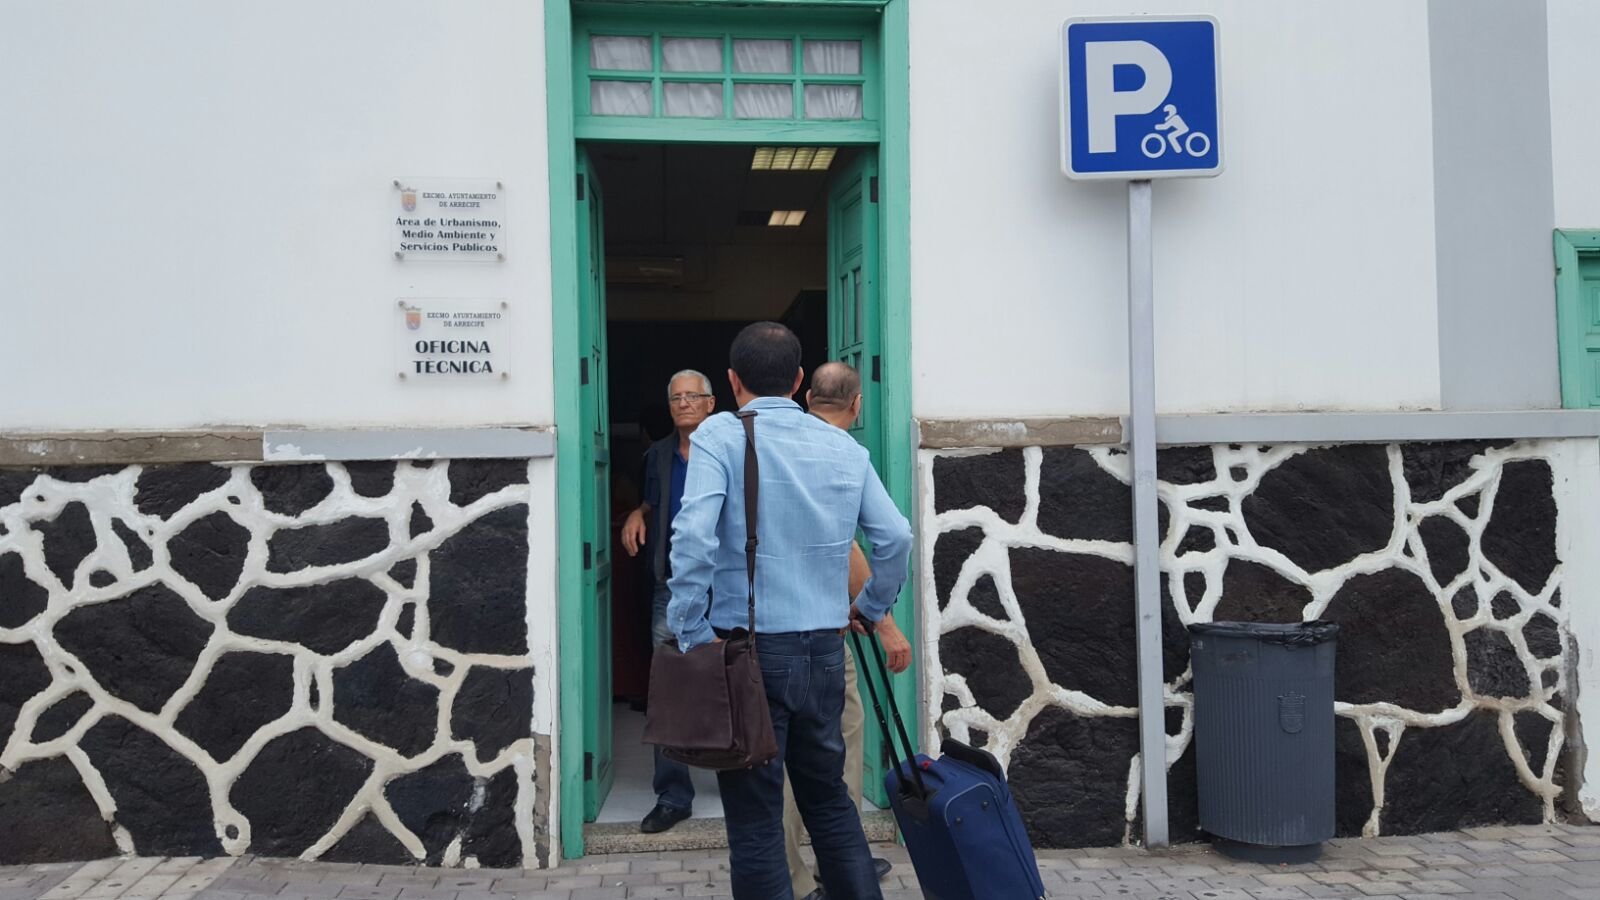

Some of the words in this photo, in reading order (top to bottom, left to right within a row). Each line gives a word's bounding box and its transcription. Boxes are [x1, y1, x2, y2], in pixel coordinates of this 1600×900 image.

[1085, 40, 1173, 154] P
[424, 218, 437, 226] de
[440, 218, 501, 228] Urbanismo,
[402, 230, 434, 239] Medio
[437, 230, 487, 239] Ambiente
[489, 233, 496, 241] y
[400, 242, 449, 251] Servicios
[453, 312, 501, 320] AYUNTAMIENTO
[415, 340, 491, 354] OFICINA
